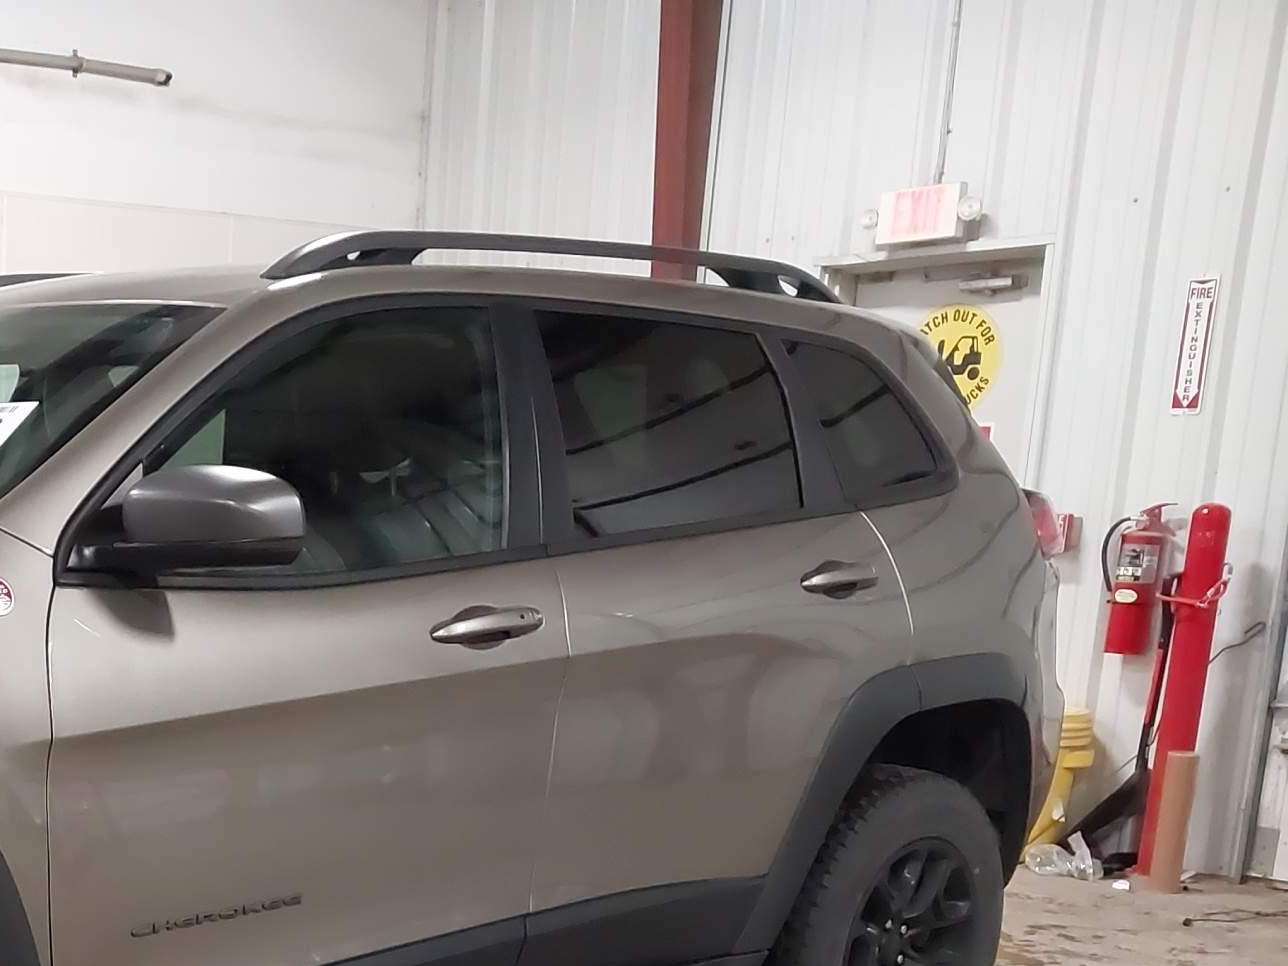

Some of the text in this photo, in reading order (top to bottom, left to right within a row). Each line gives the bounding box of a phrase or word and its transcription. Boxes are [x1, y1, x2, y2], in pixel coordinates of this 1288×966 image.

[1190, 287, 1214, 300] FIRE
[953, 309, 978, 325] OUT
[975, 319, 995, 346] FOR
[1182, 301, 1203, 402] EXTINGUISHER
